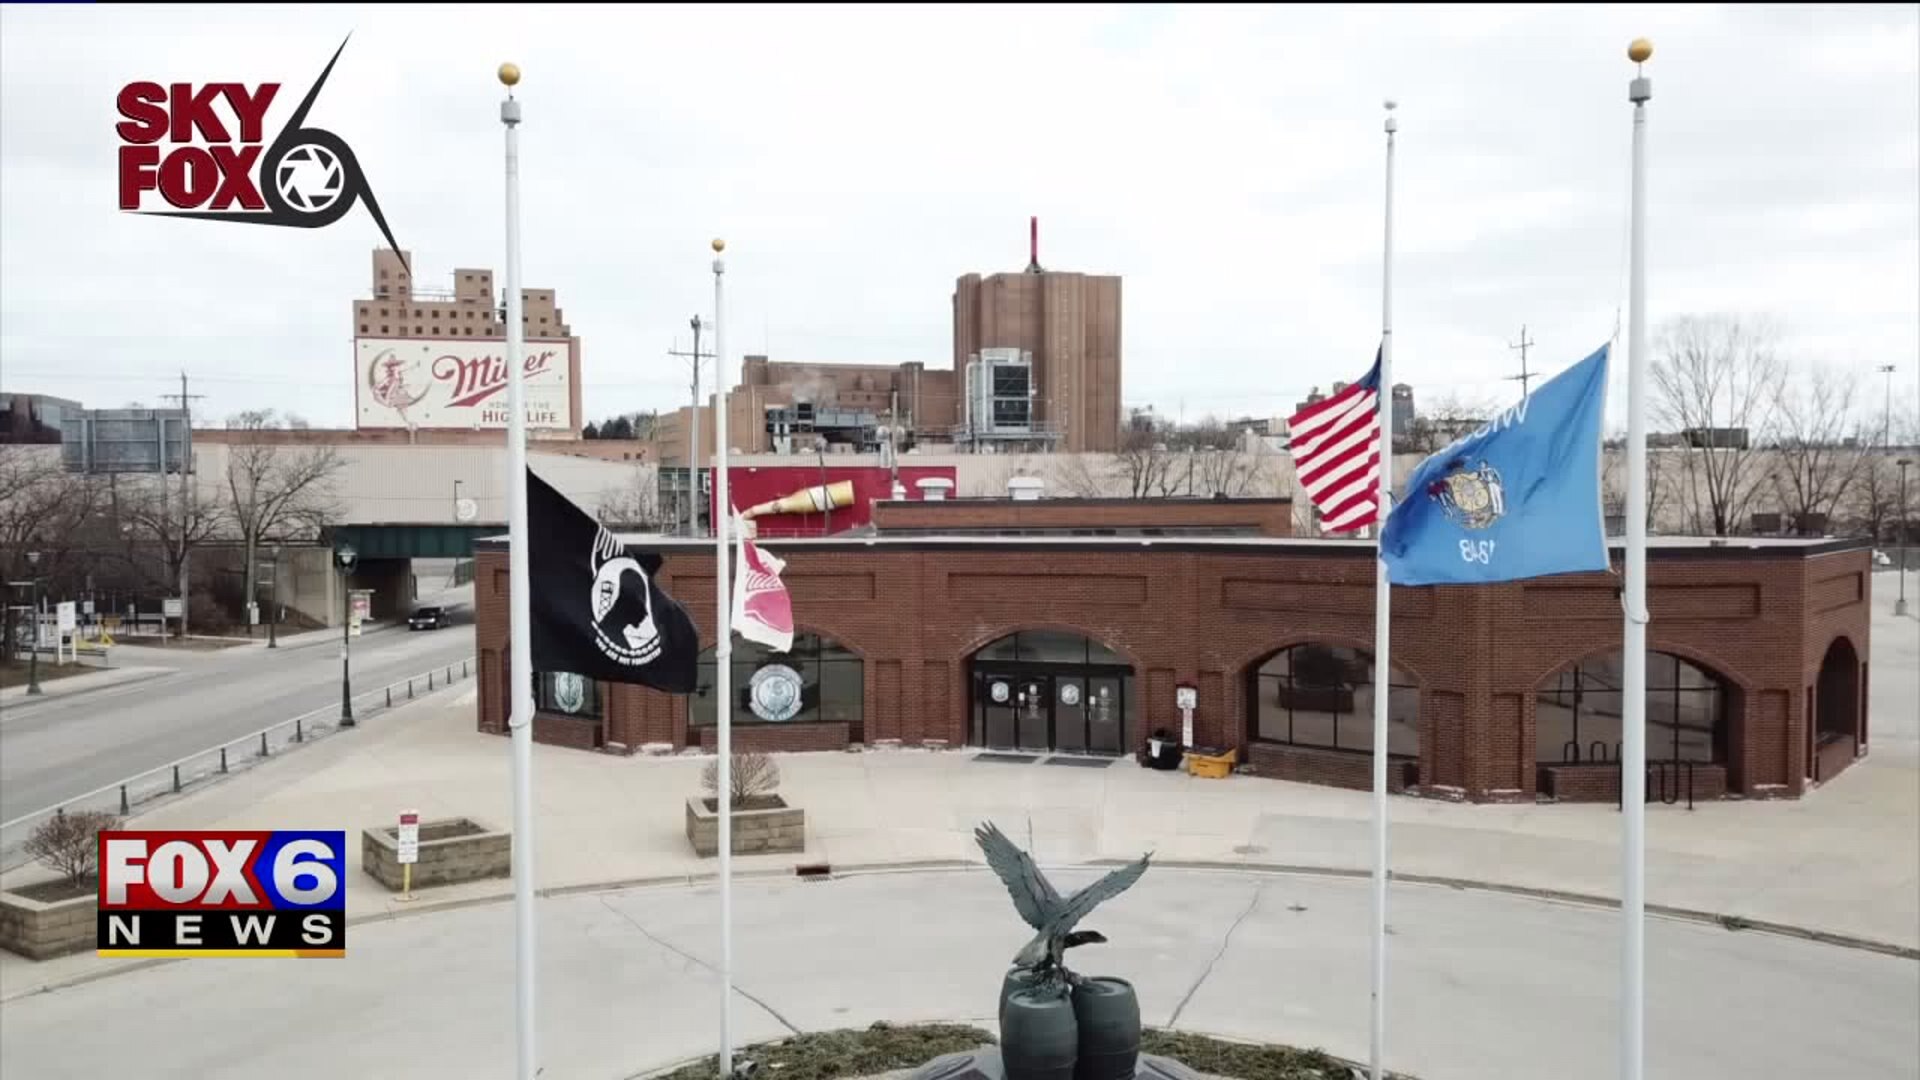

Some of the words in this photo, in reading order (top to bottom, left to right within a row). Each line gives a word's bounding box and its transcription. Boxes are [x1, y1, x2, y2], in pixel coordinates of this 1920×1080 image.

[432, 350, 557, 399] Mier
[482, 410, 520, 422] HIG
[527, 411, 557, 422] LIFE
